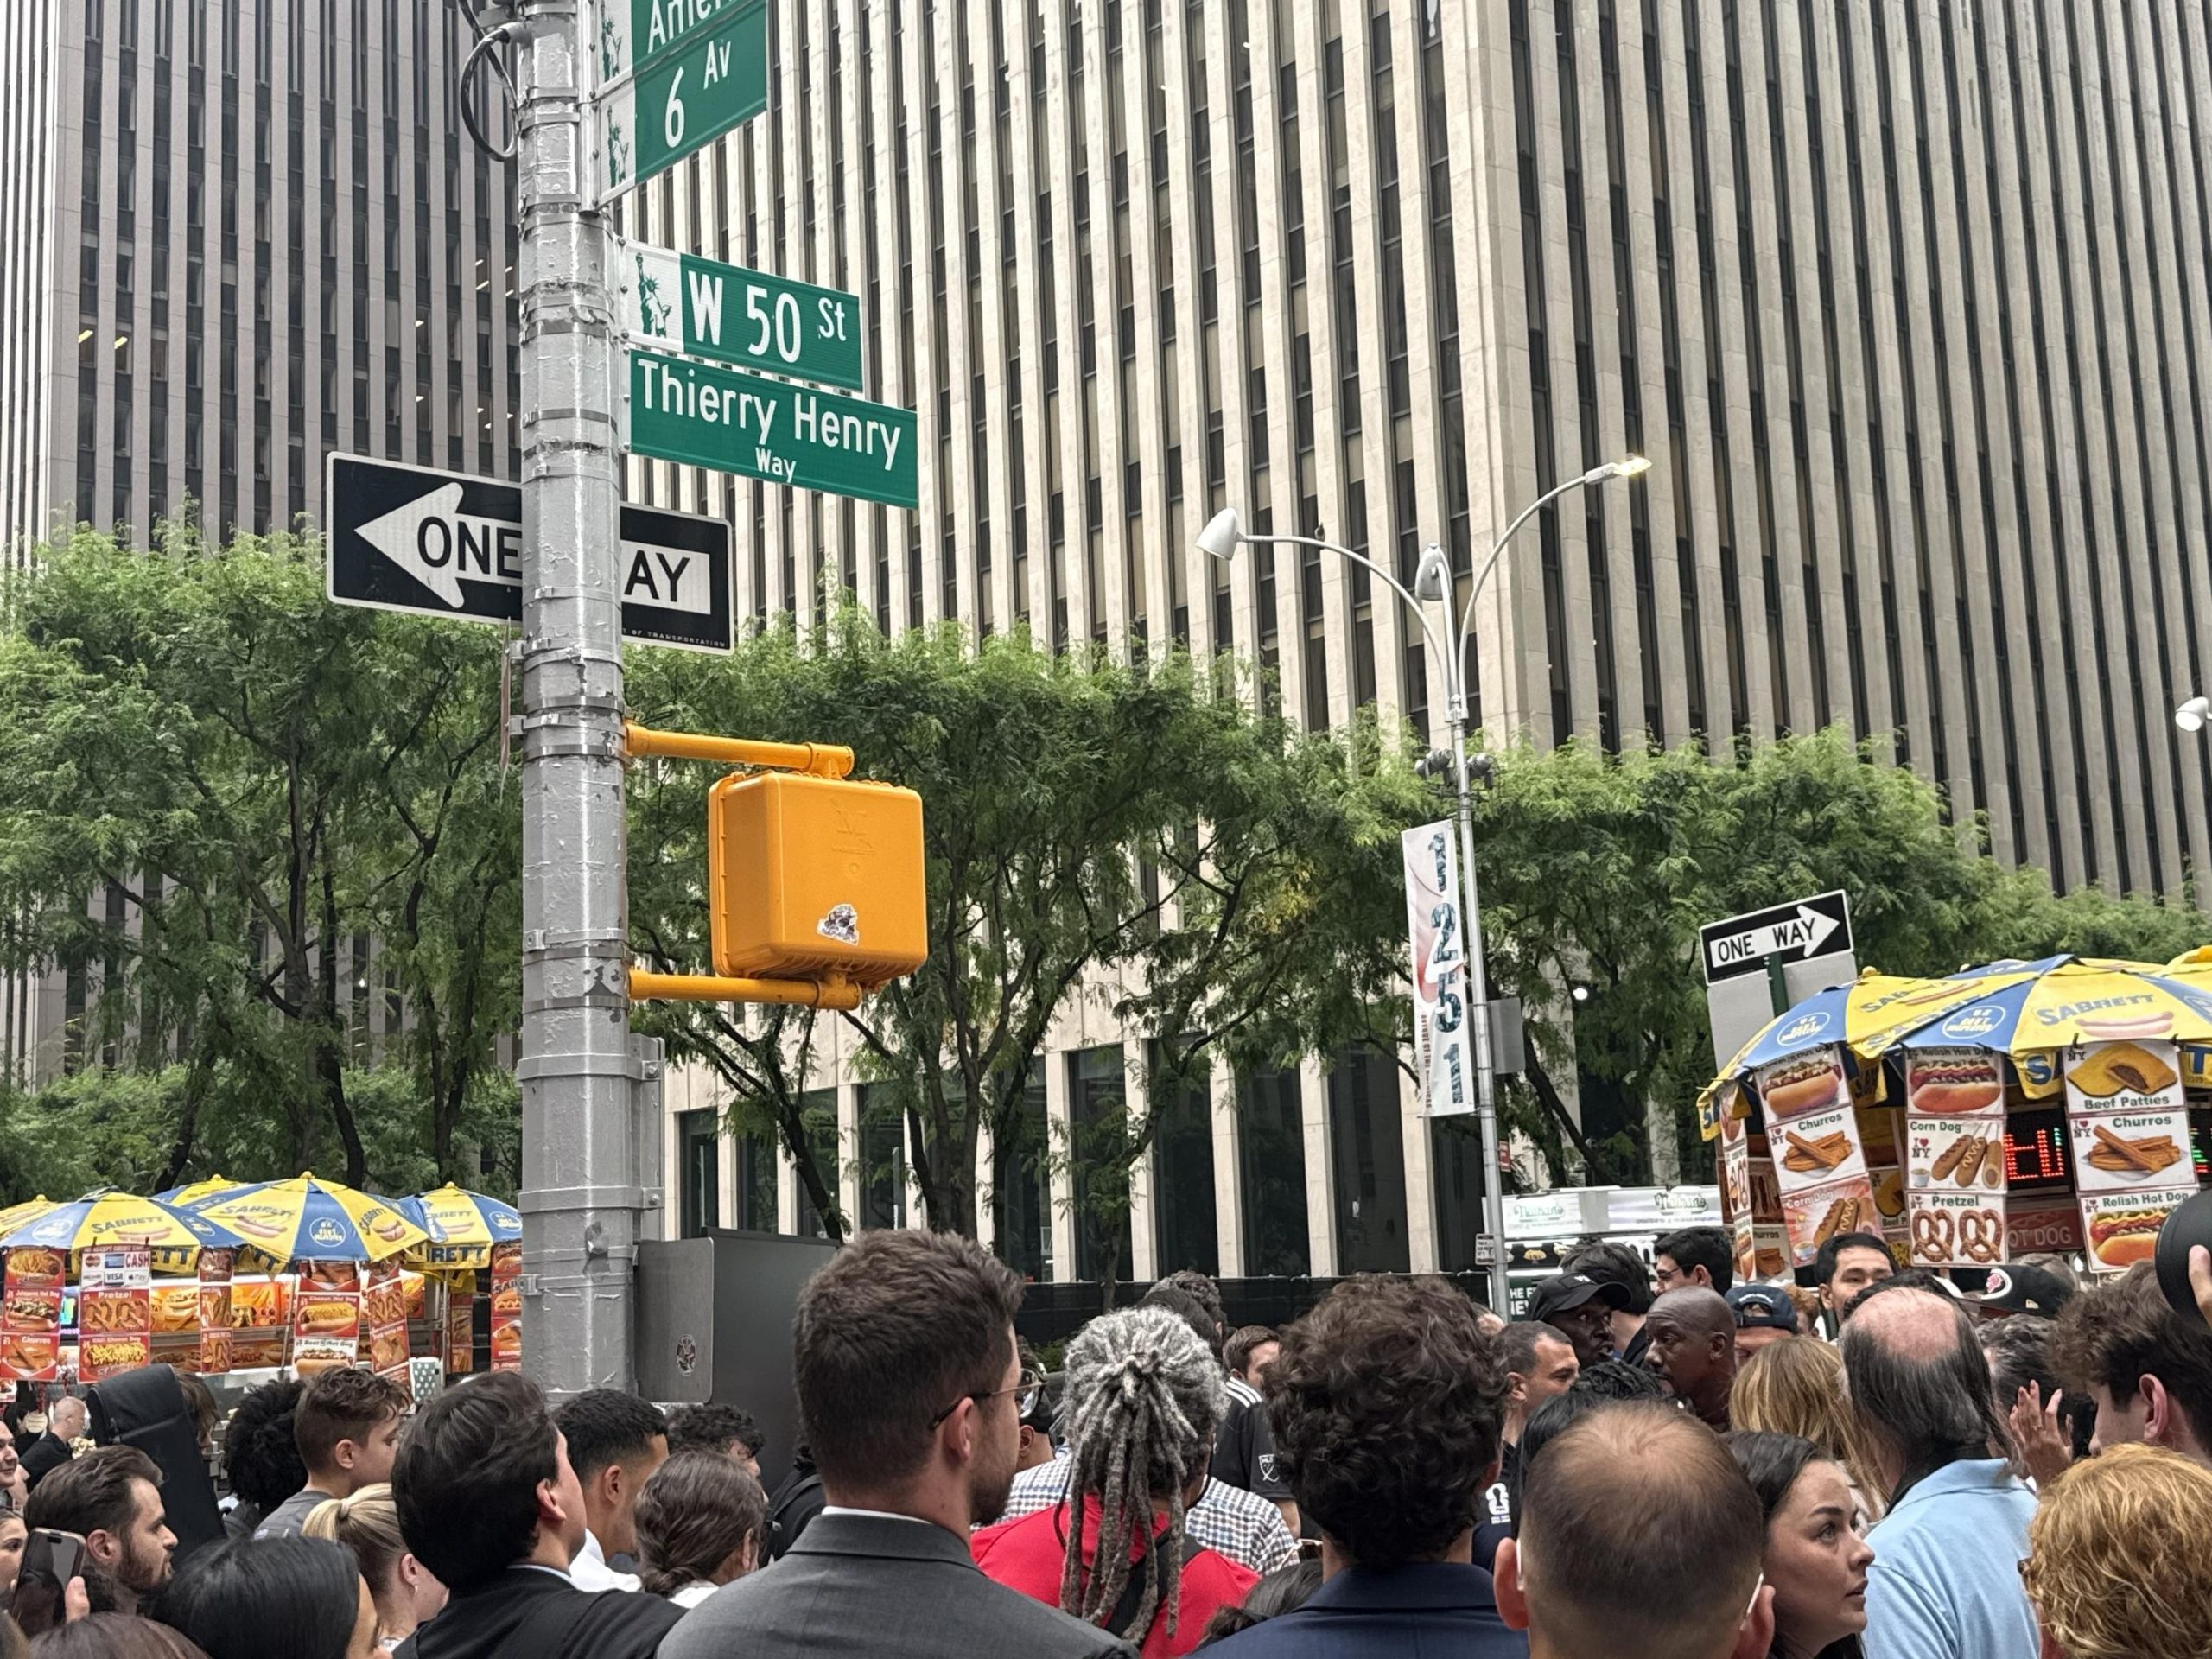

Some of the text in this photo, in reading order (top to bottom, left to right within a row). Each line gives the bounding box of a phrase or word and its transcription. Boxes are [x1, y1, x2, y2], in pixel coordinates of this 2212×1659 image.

[648, 0, 734, 54] Ame
[665, 40, 731, 148] 6 Av
[687, 270, 846, 364] W 50 St
[637, 358, 901, 471] Thierry Henry
[754, 447, 796, 484] Way
[417, 516, 690, 603] ONE AY
[647, 631, 726, 647] TRANSPORTATION
[1718, 917, 1815, 963] ONE WAY
[1428, 832, 1465, 1104] 1251
[2036, 994, 2154, 1027] SABRETT
[2084, 1096, 2170, 1109] Beef Patties
[1798, 1112, 1843, 1131] Churros
[1910, 1121, 1962, 1134] Corn Dog
[2113, 1116, 2172, 1128] Churros
[1912, 1147, 1931, 1159] NY
[1786, 1191, 1834, 1210] Corn Dog
[1932, 1195, 1979, 1206] Pretzel
[2103, 1196, 2139, 1207] Relish
[2142, 1194, 2163, 1204] Hot
[91, 1216, 163, 1234] SABRETT
[2008, 1226, 2072, 1248] OT DOG
[126, 1253, 149, 1268] CASH
[431, 1246, 487, 1262] RETT
[106, 1273, 124, 1281] VISA
